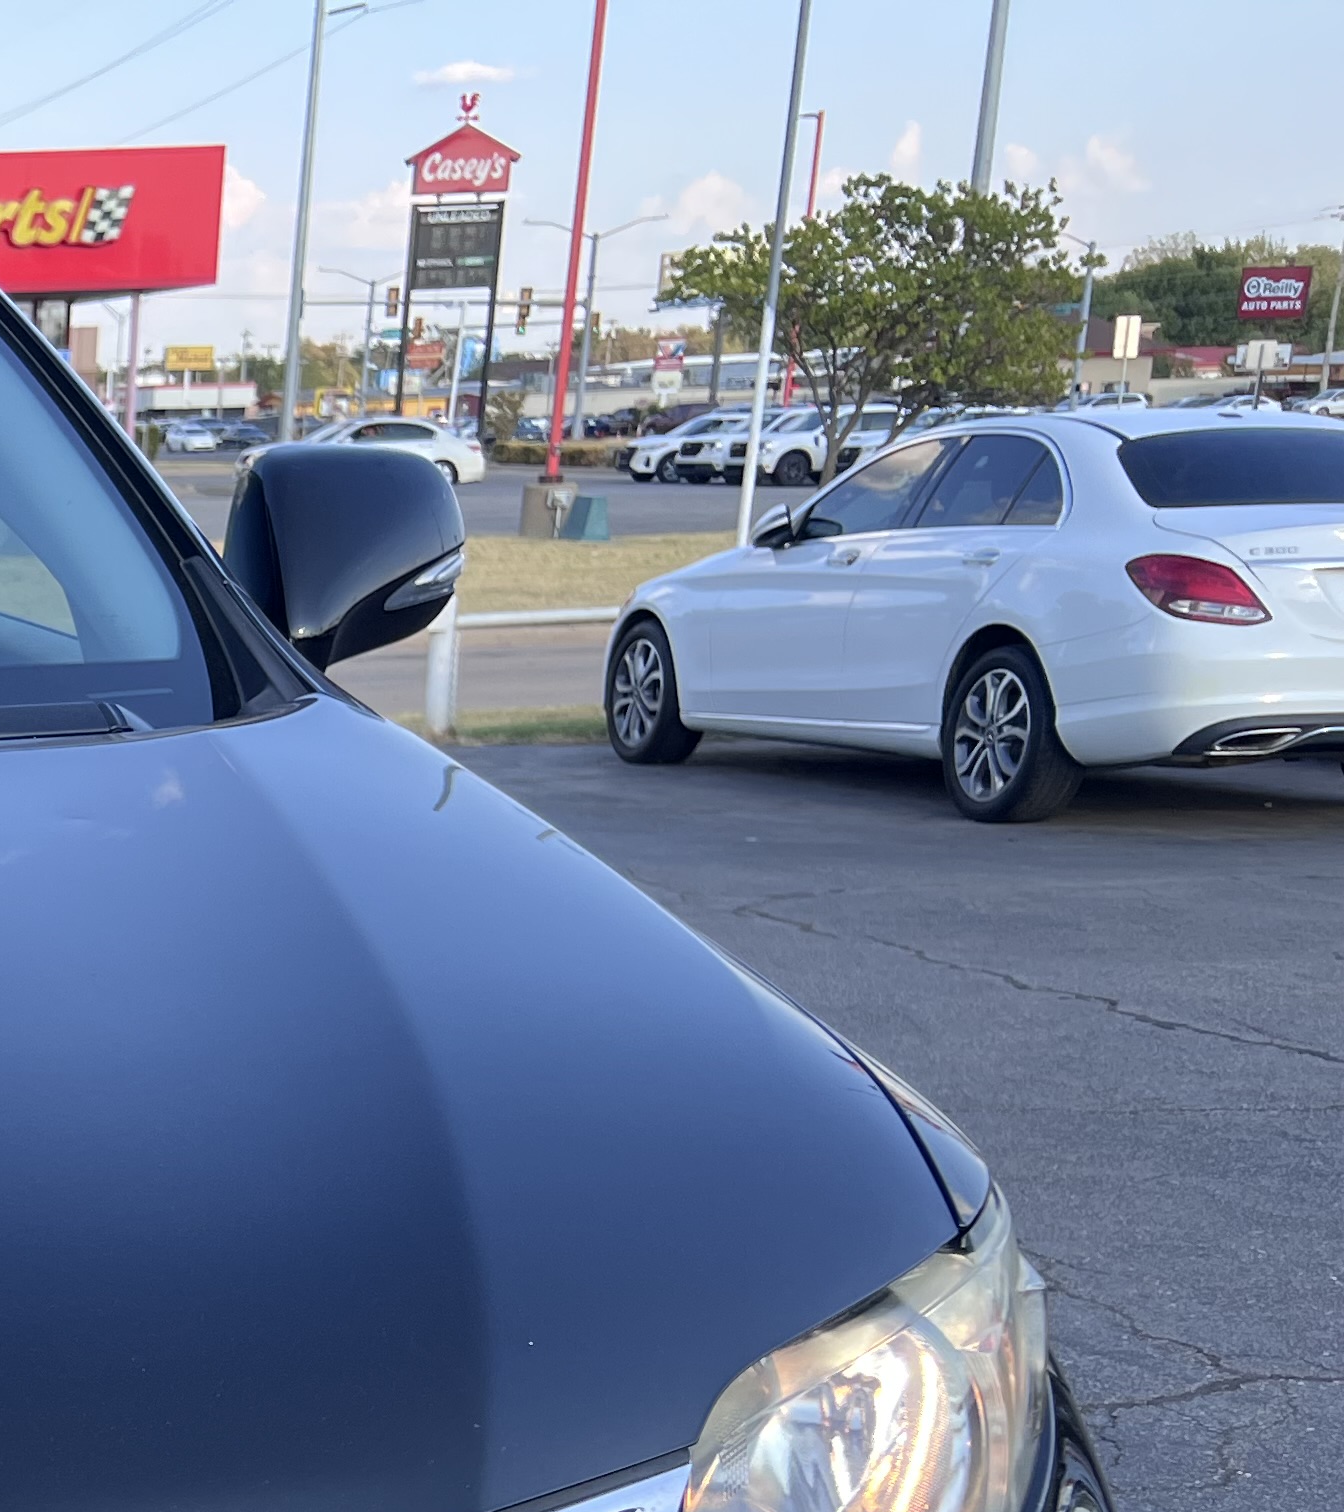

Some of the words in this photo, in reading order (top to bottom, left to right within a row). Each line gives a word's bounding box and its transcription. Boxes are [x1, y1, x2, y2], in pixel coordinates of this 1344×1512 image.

[421, 151, 507, 187] Casey's
[1244, 277, 1304, 298] O'Reilly
[1241, 301, 1268, 311] AUTO
[1270, 300, 1302, 311] PARTS
